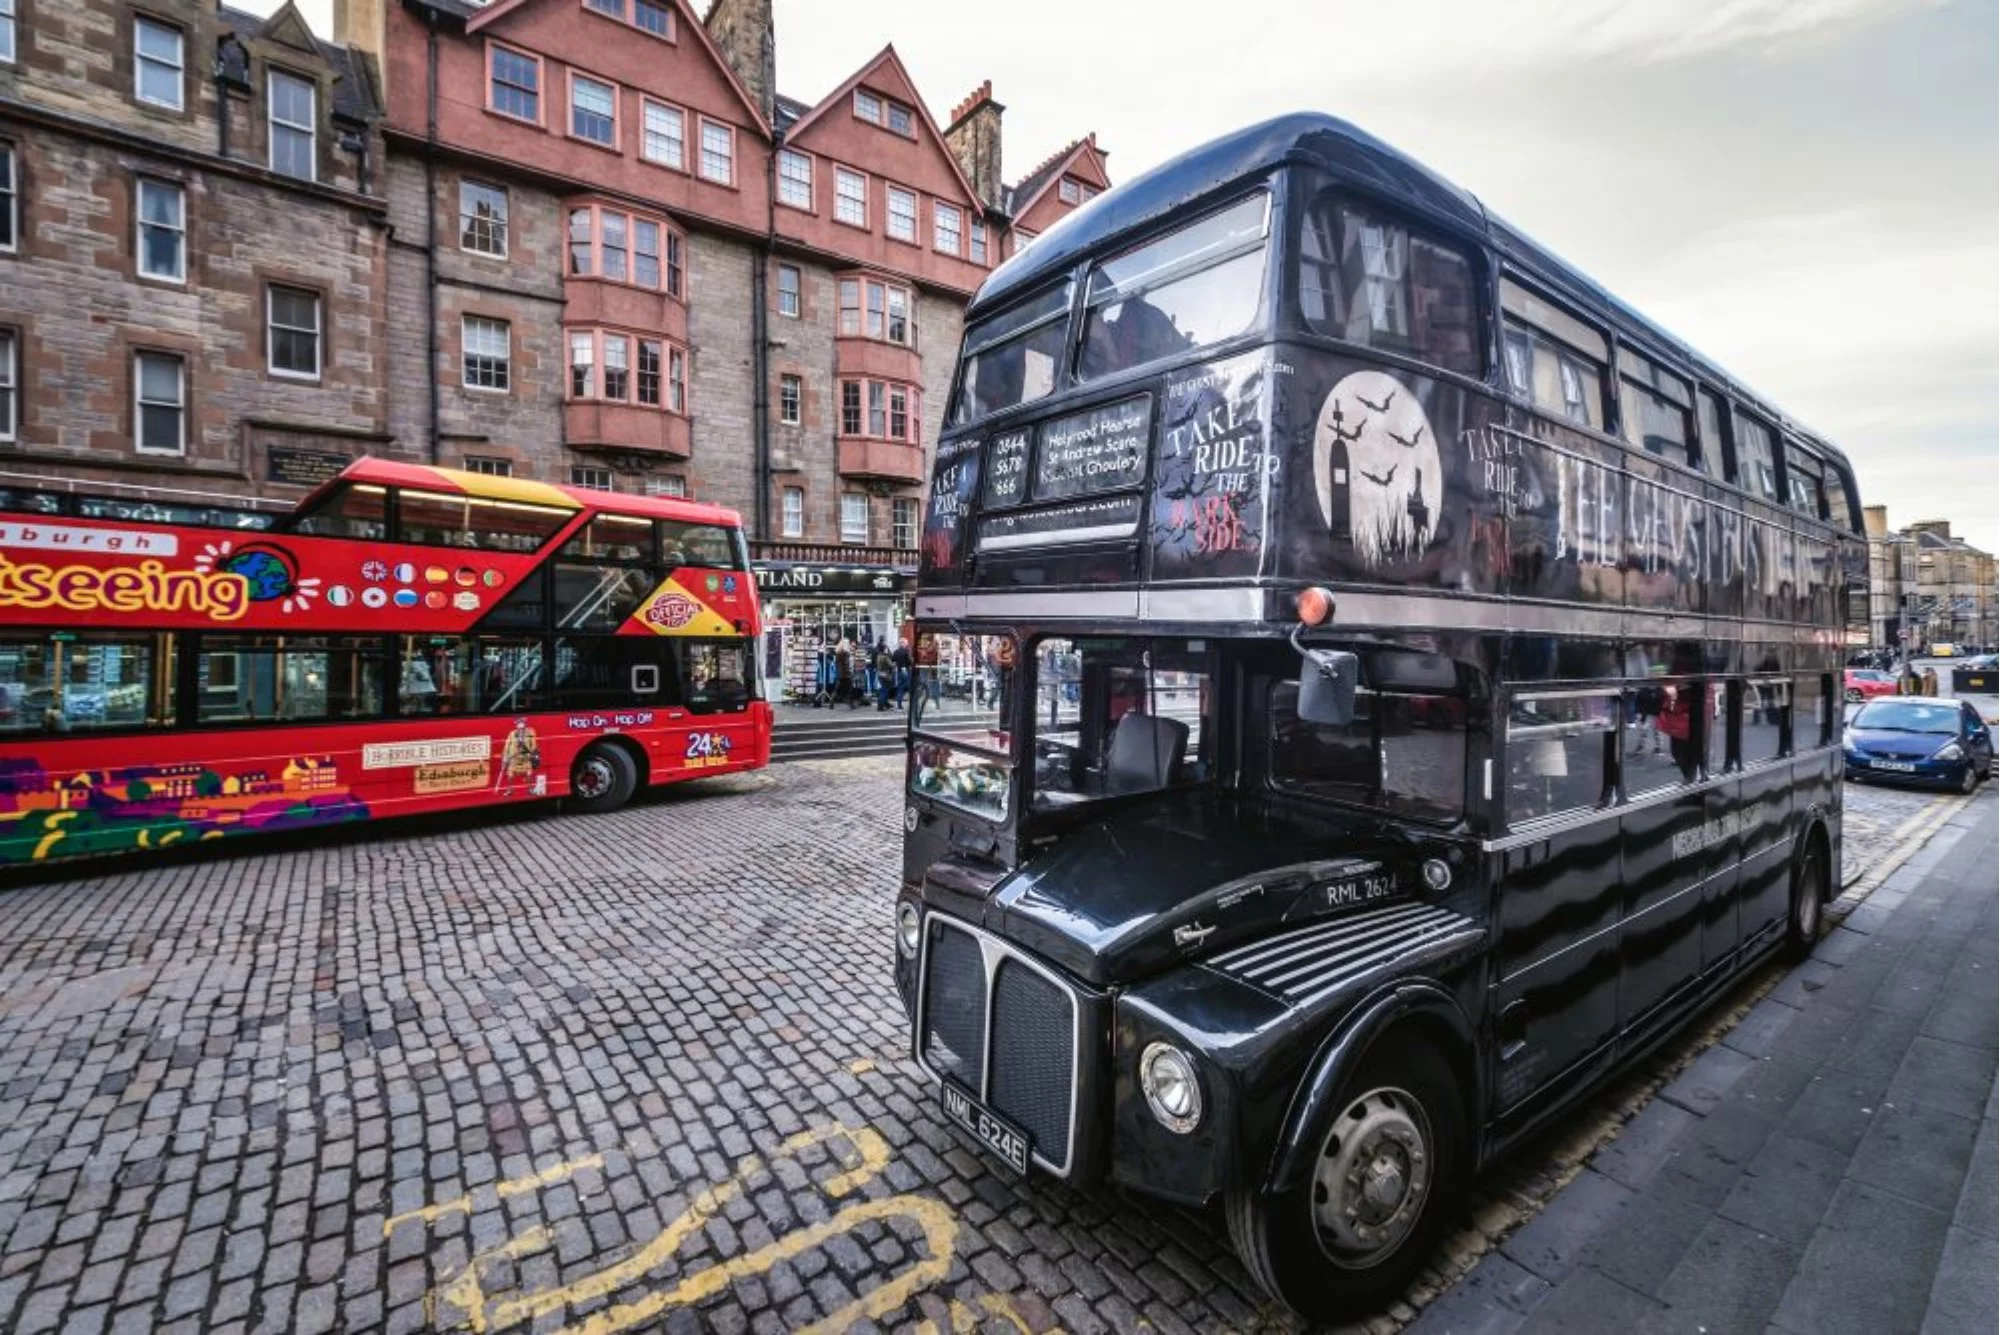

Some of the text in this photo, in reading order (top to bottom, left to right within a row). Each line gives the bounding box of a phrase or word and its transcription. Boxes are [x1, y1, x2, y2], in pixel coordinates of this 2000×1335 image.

[1049, 415, 1142, 448] Holyrood Hearse
[1167, 399, 1242, 457] TAKE
[1193, 435, 1281, 475] RIDE TO
[1215, 472, 1250, 493] THE
[0, 527, 150, 550] burgh
[756, 570, 823, 587] TLAND
[569, 716, 590, 729] Hop
[615, 714, 635, 726] Hop
[686, 732, 711, 758] 24
[1327, 883, 1362, 906] RML
[946, 1087, 1024, 1169] NML 624E
